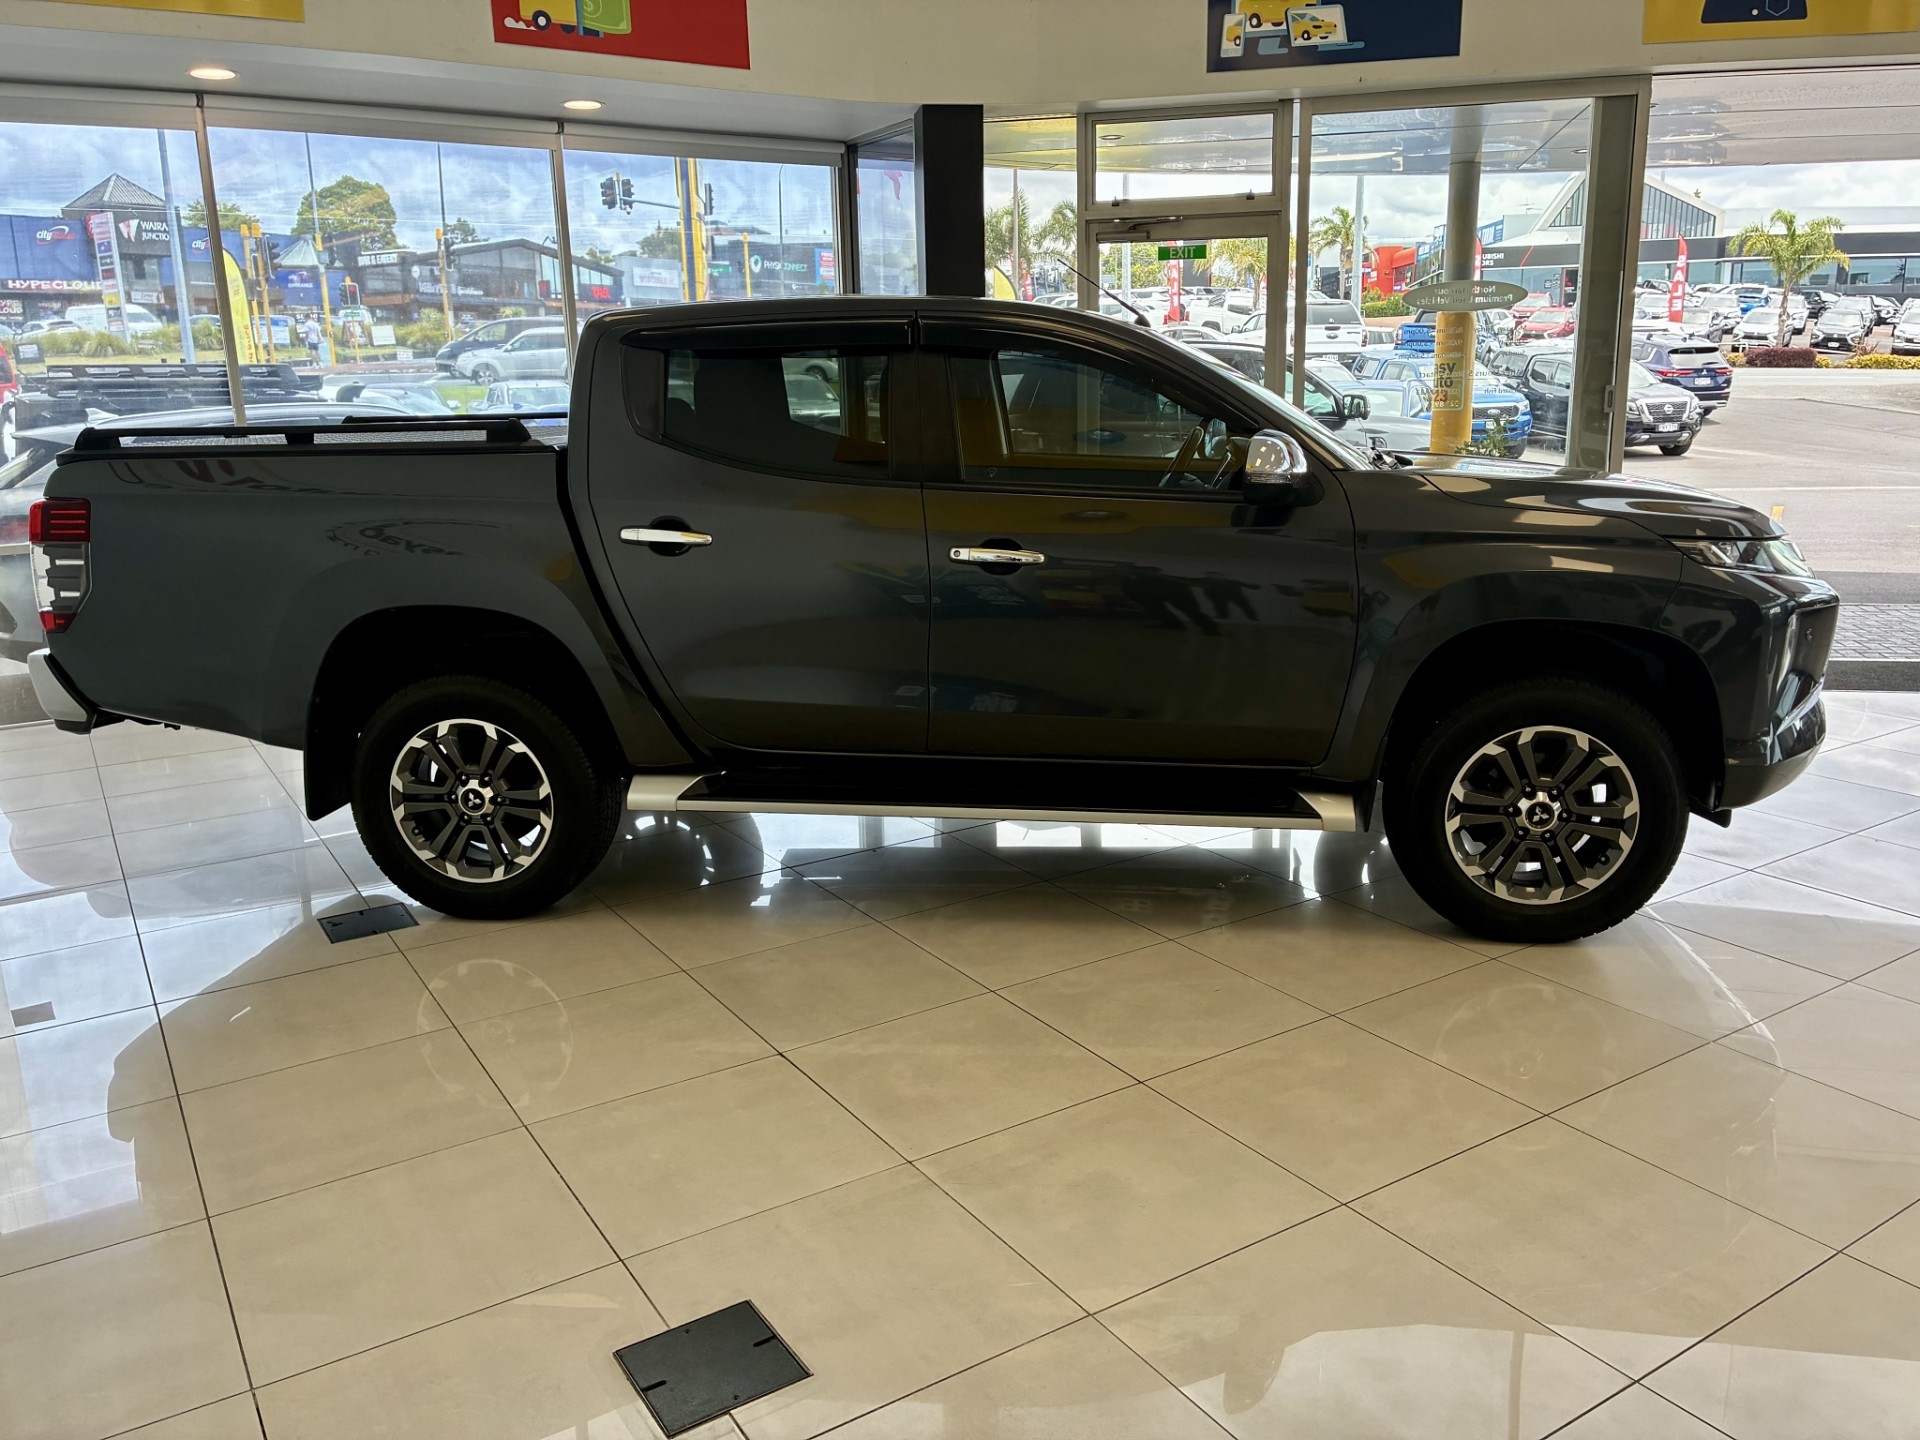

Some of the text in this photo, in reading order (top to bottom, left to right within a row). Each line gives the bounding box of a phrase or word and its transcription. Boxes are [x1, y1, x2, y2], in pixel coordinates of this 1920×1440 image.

[140, 220, 169, 231] WAIRA
[141, 232, 170, 241] JUNCTIO
[1169, 246, 1196, 259] EXIT
